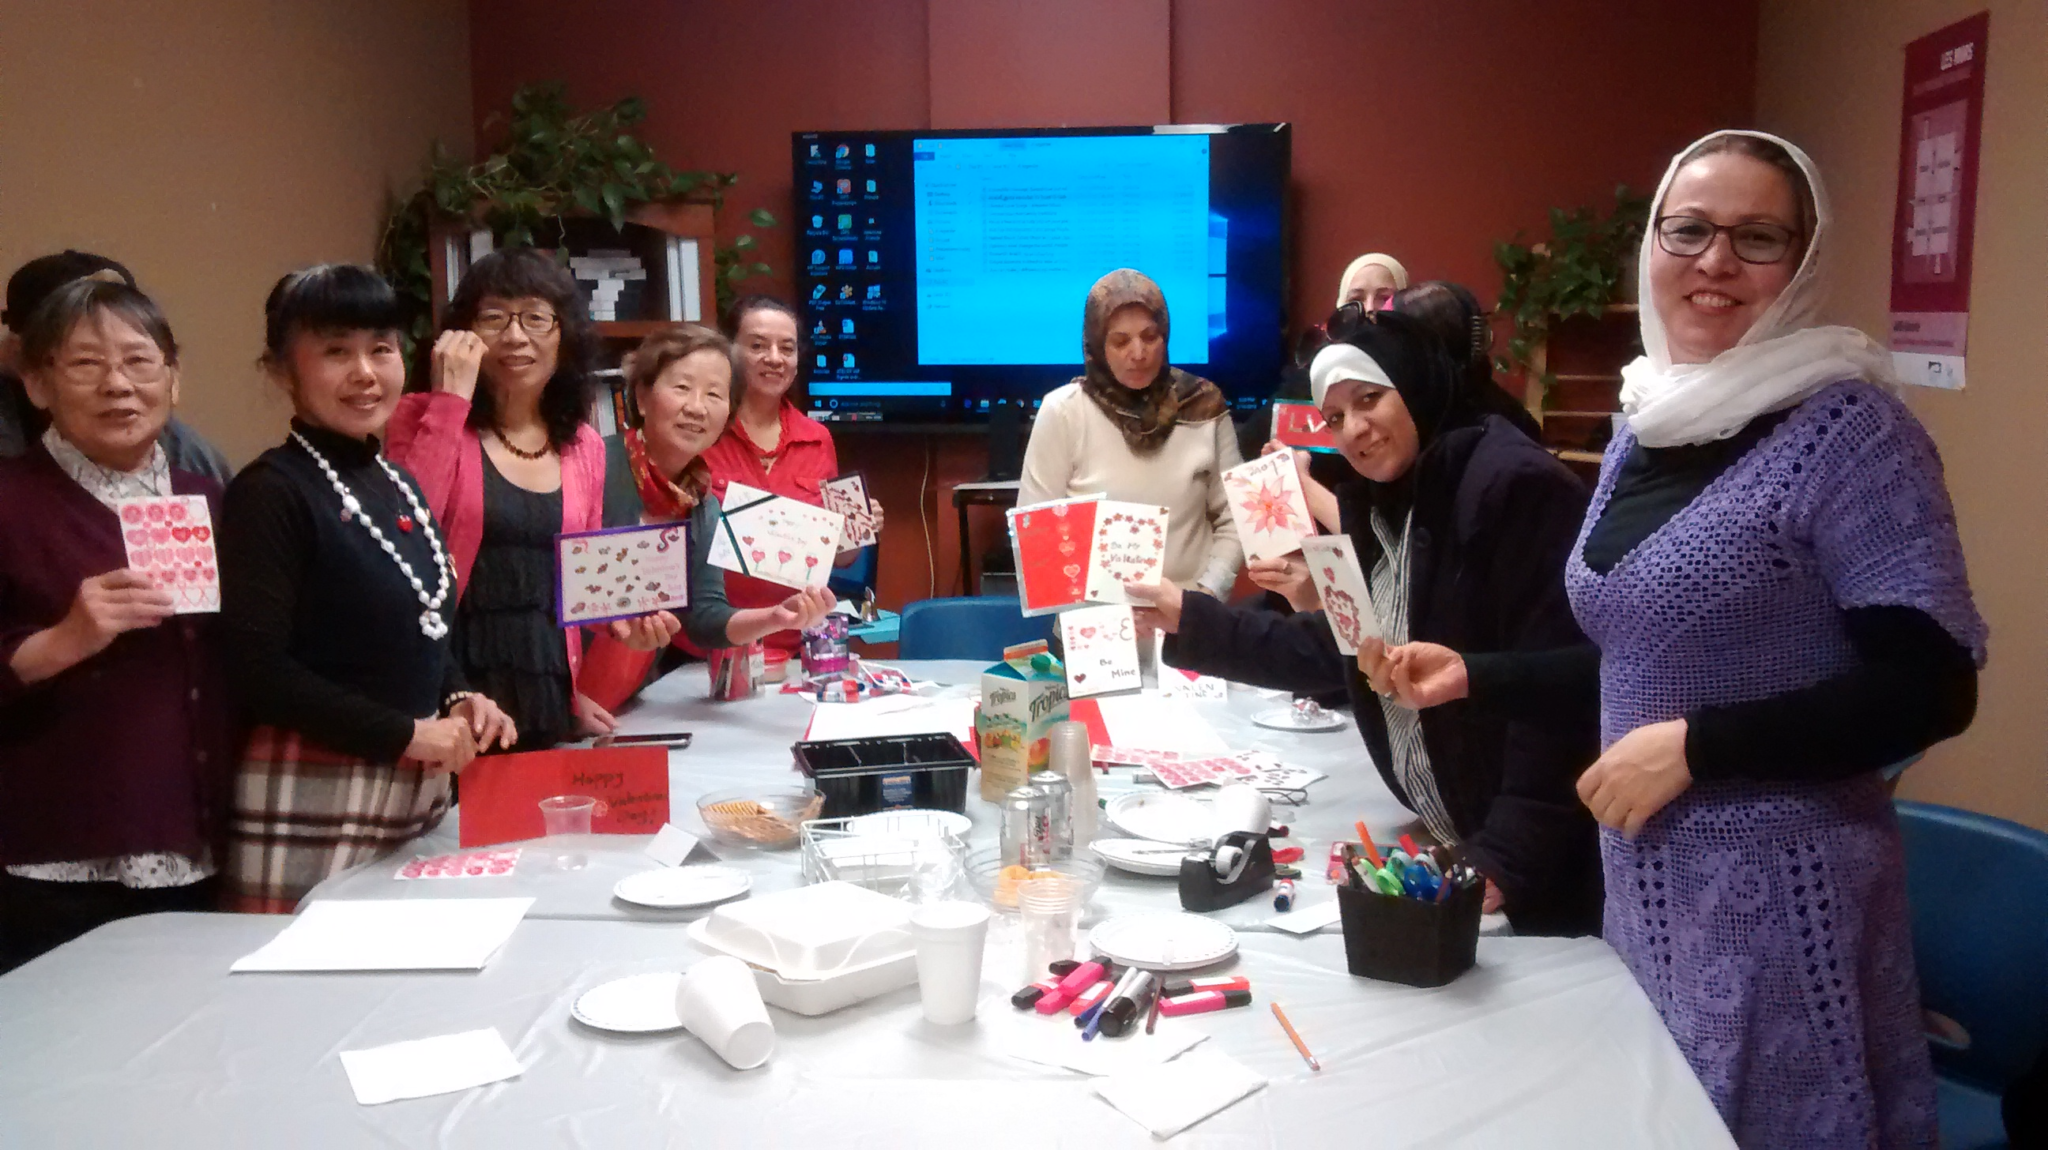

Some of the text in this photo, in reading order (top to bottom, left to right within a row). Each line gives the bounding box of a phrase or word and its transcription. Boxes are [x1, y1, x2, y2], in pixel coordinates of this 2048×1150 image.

[1110, 553, 1149, 565] Valentin
[1099, 658, 1113, 666] Be
[1111, 667, 1137, 679] Mine
[572, 772, 624, 789] Happy
